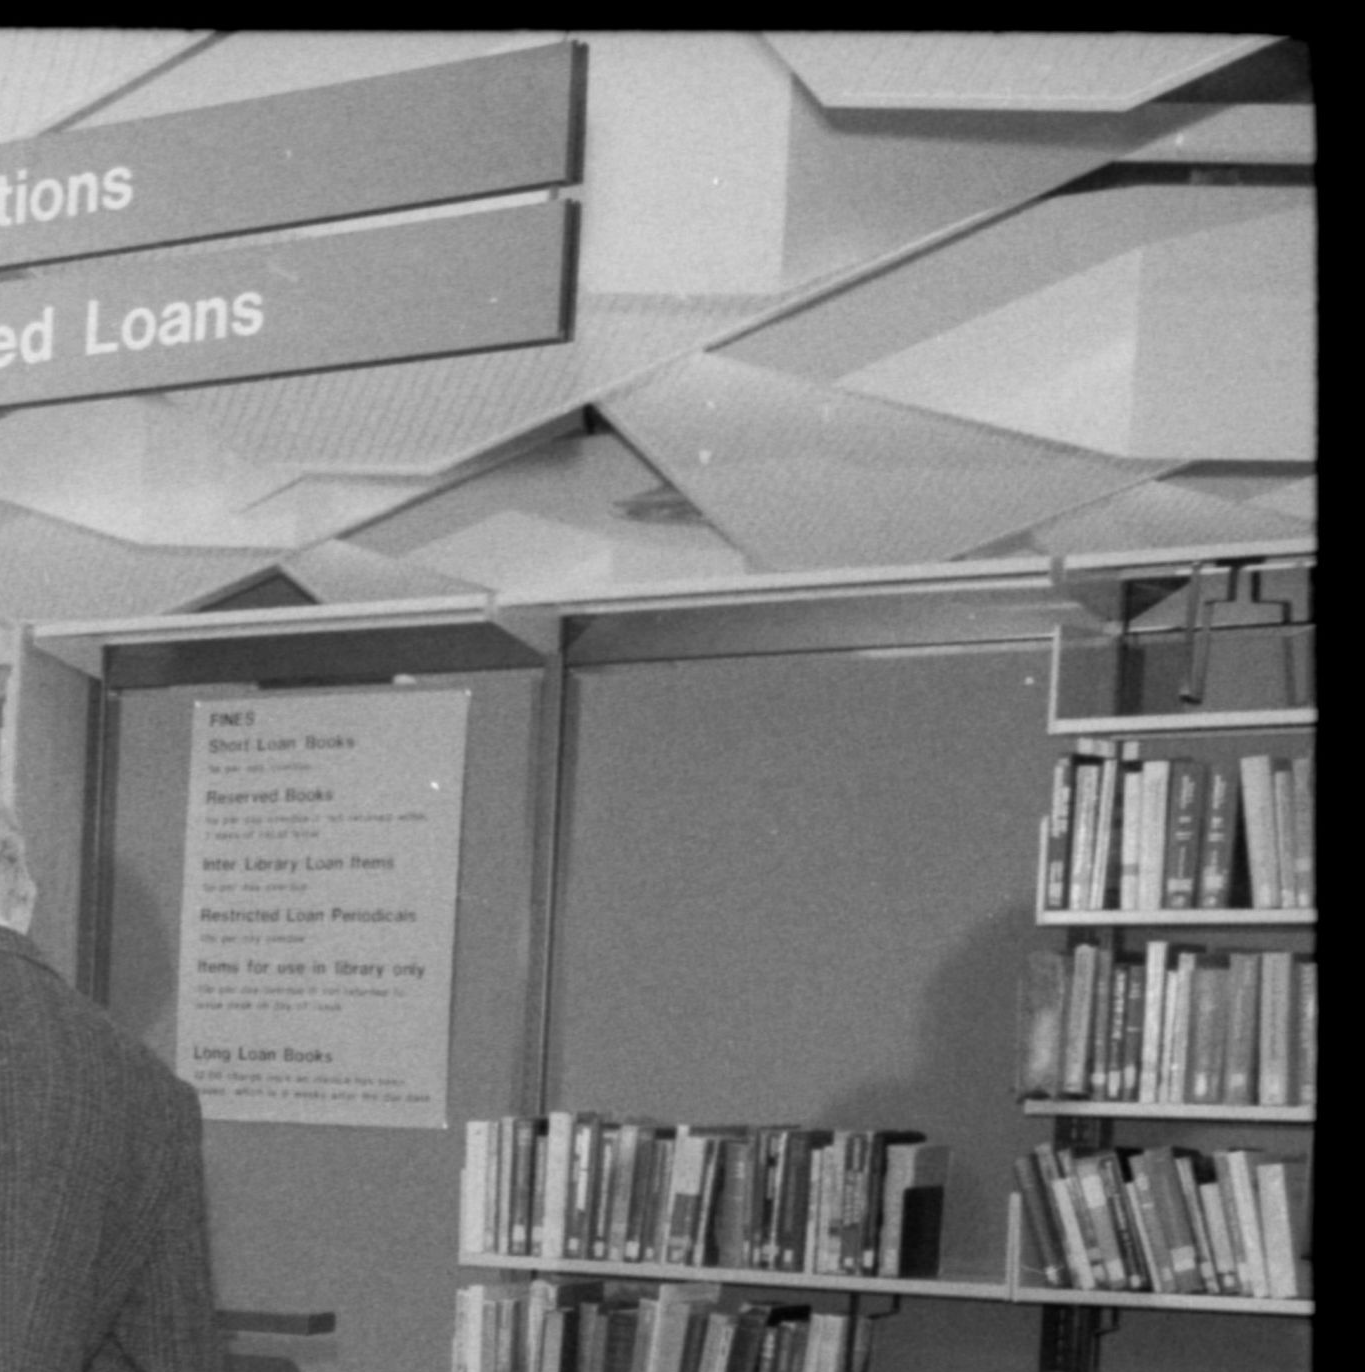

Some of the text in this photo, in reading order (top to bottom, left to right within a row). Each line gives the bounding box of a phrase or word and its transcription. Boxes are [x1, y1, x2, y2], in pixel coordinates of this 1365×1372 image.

[85, 291, 266, 357] Loans
[209, 711, 255, 727] FINES
[209, 735, 356, 754] Short Loan Books
[206, 788, 335, 805] Reserved Books
[202, 856, 395, 873] Inter Library Loan Items
[200, 907, 417, 923] Restricted Loan Periodicals
[197, 959, 426, 979] Items for use in library only
[193, 1046, 333, 1064] Long Loan Books
